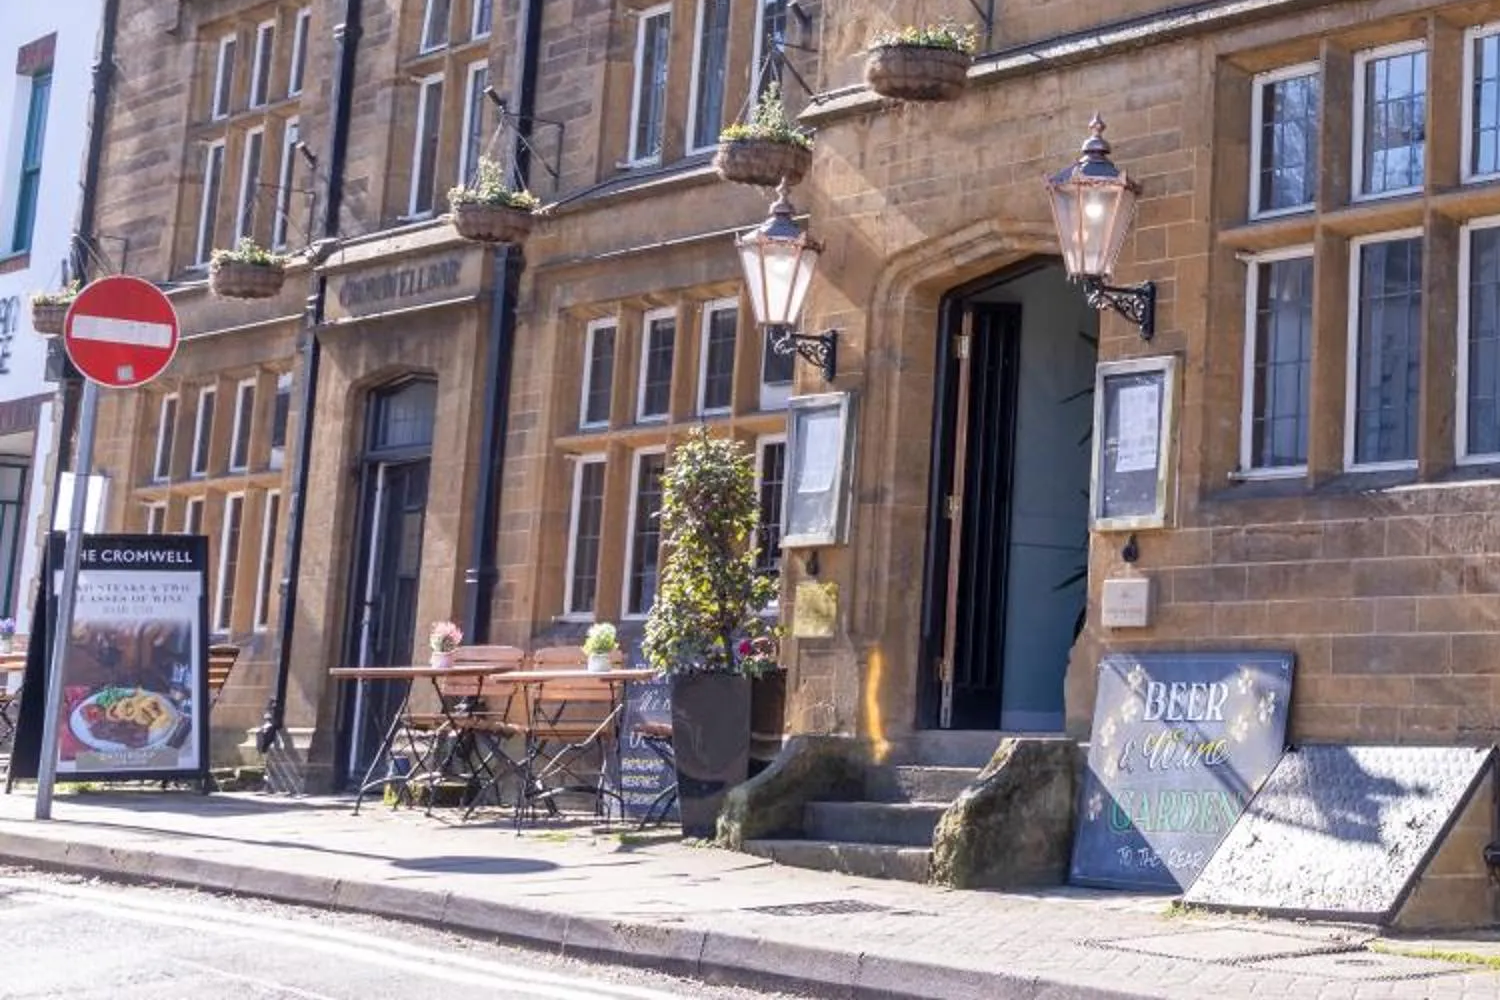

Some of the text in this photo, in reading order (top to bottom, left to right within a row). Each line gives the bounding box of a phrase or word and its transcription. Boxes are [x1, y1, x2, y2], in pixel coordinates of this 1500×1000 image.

[80, 549, 193, 564] HE CROMWELL
[1143, 681, 1229, 722] BEER
[1143, 728, 1232, 769] Wine
[1107, 788, 1247, 834] GARDEN
